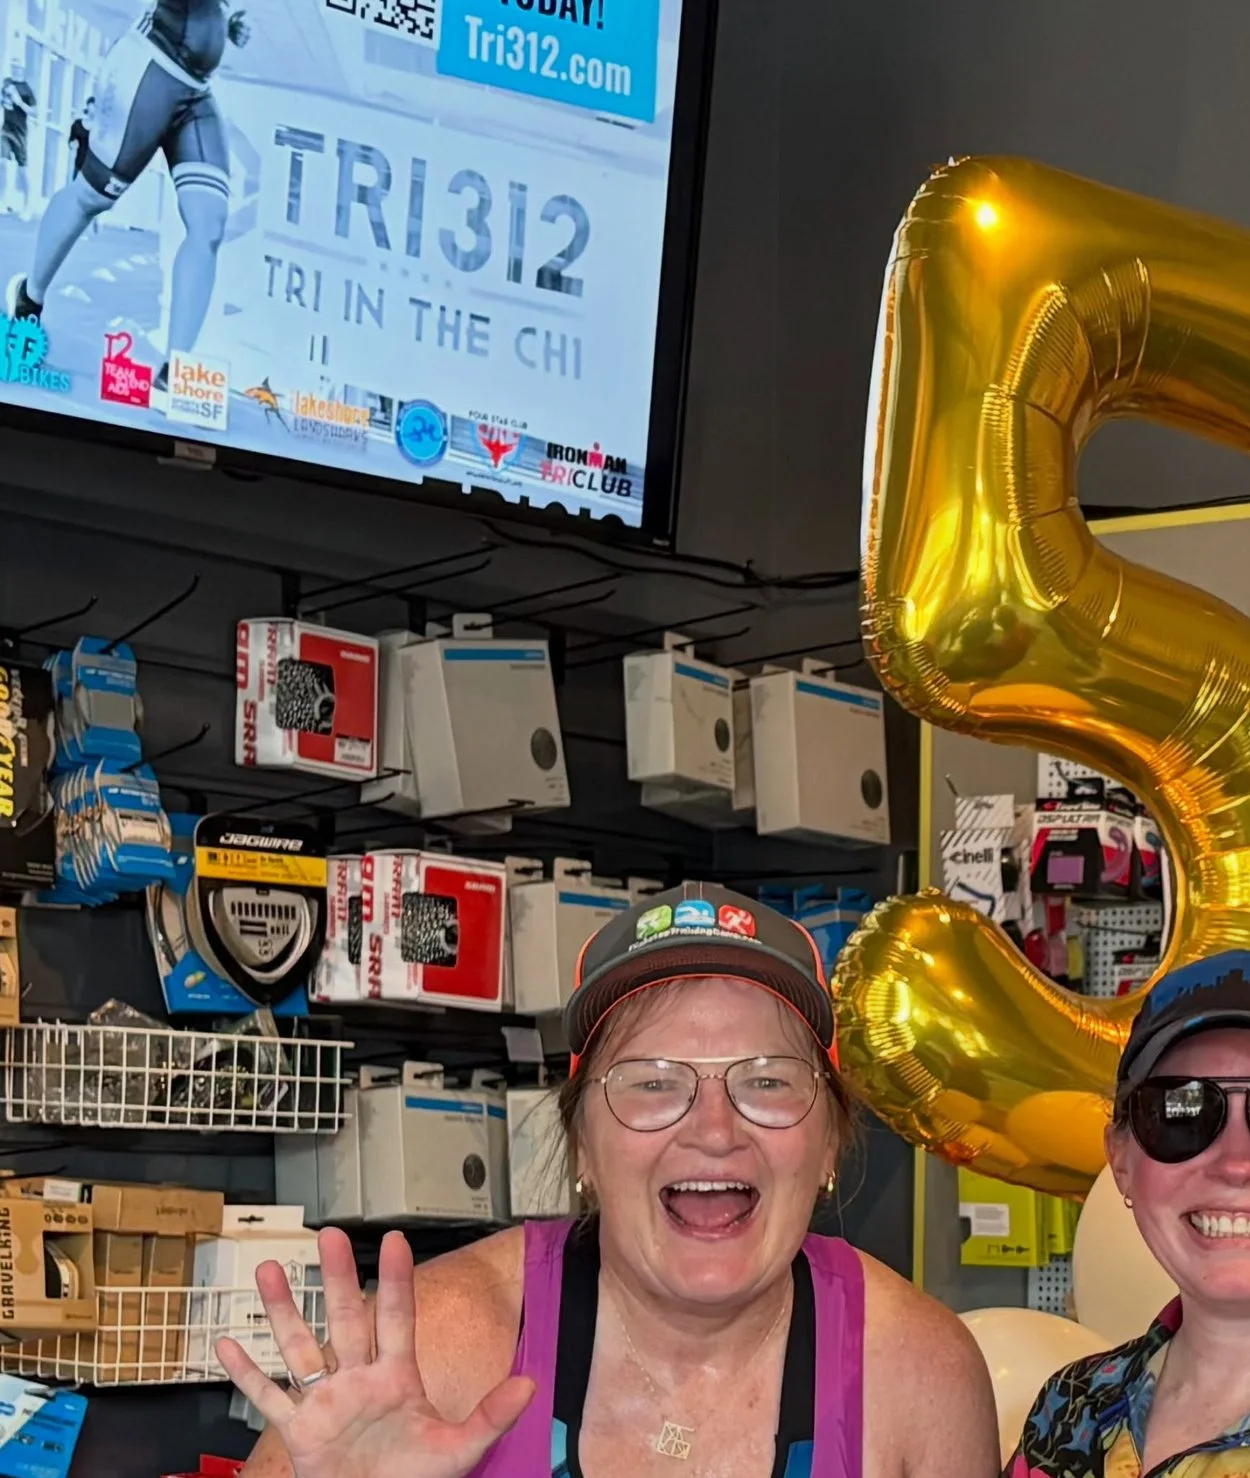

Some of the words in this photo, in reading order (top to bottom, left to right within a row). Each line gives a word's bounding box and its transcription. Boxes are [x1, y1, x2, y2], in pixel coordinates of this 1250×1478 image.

[464, 15, 632, 96] Tri312.com
[274, 124, 590, 298] TRI312
[264, 254, 322, 313] TRI
[343, 279, 385, 329] IN
[409, 296, 490, 358] THE
[514, 326, 583, 381] CHI
[20, 365, 70, 392] BIKES
[174, 357, 226, 387] lake
[173, 378, 225, 403] shore
[200, 402, 224, 420] SF
[546, 441, 627, 475] IRONMAN
[952, 847, 994, 864] cinelli
